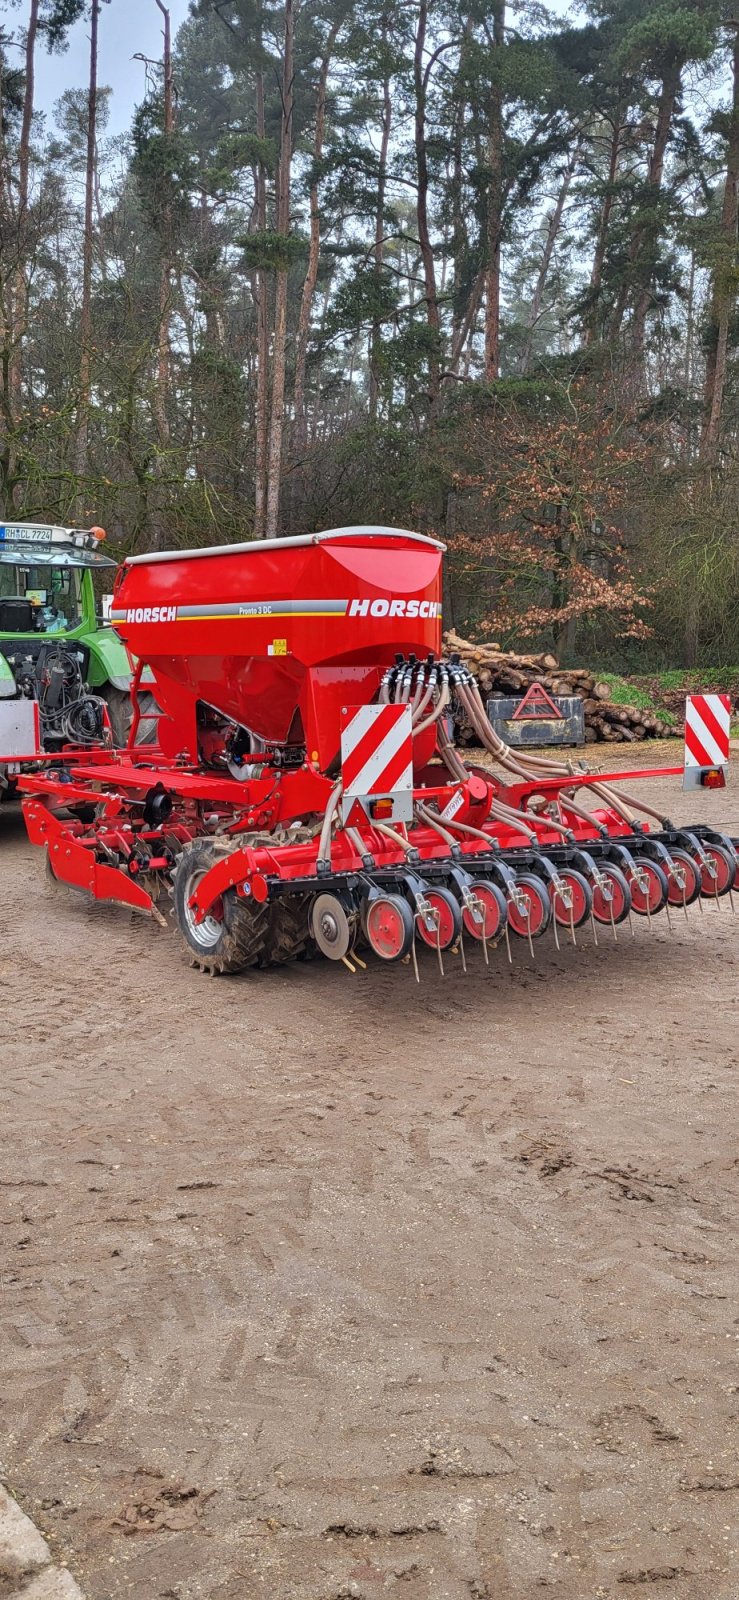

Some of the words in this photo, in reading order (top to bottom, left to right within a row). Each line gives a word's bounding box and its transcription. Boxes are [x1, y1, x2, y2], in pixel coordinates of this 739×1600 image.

[5, 529, 15, 538] RH
[20, 529, 30, 539] CL
[32, 530, 50, 540] 7724
[127, 606, 176, 624] HORSCH
[239, 607, 257, 615] Pronto
[257, 606, 262, 614] 3
[262, 605, 272, 614] DC
[348, 599, 437, 618] HORSCH
